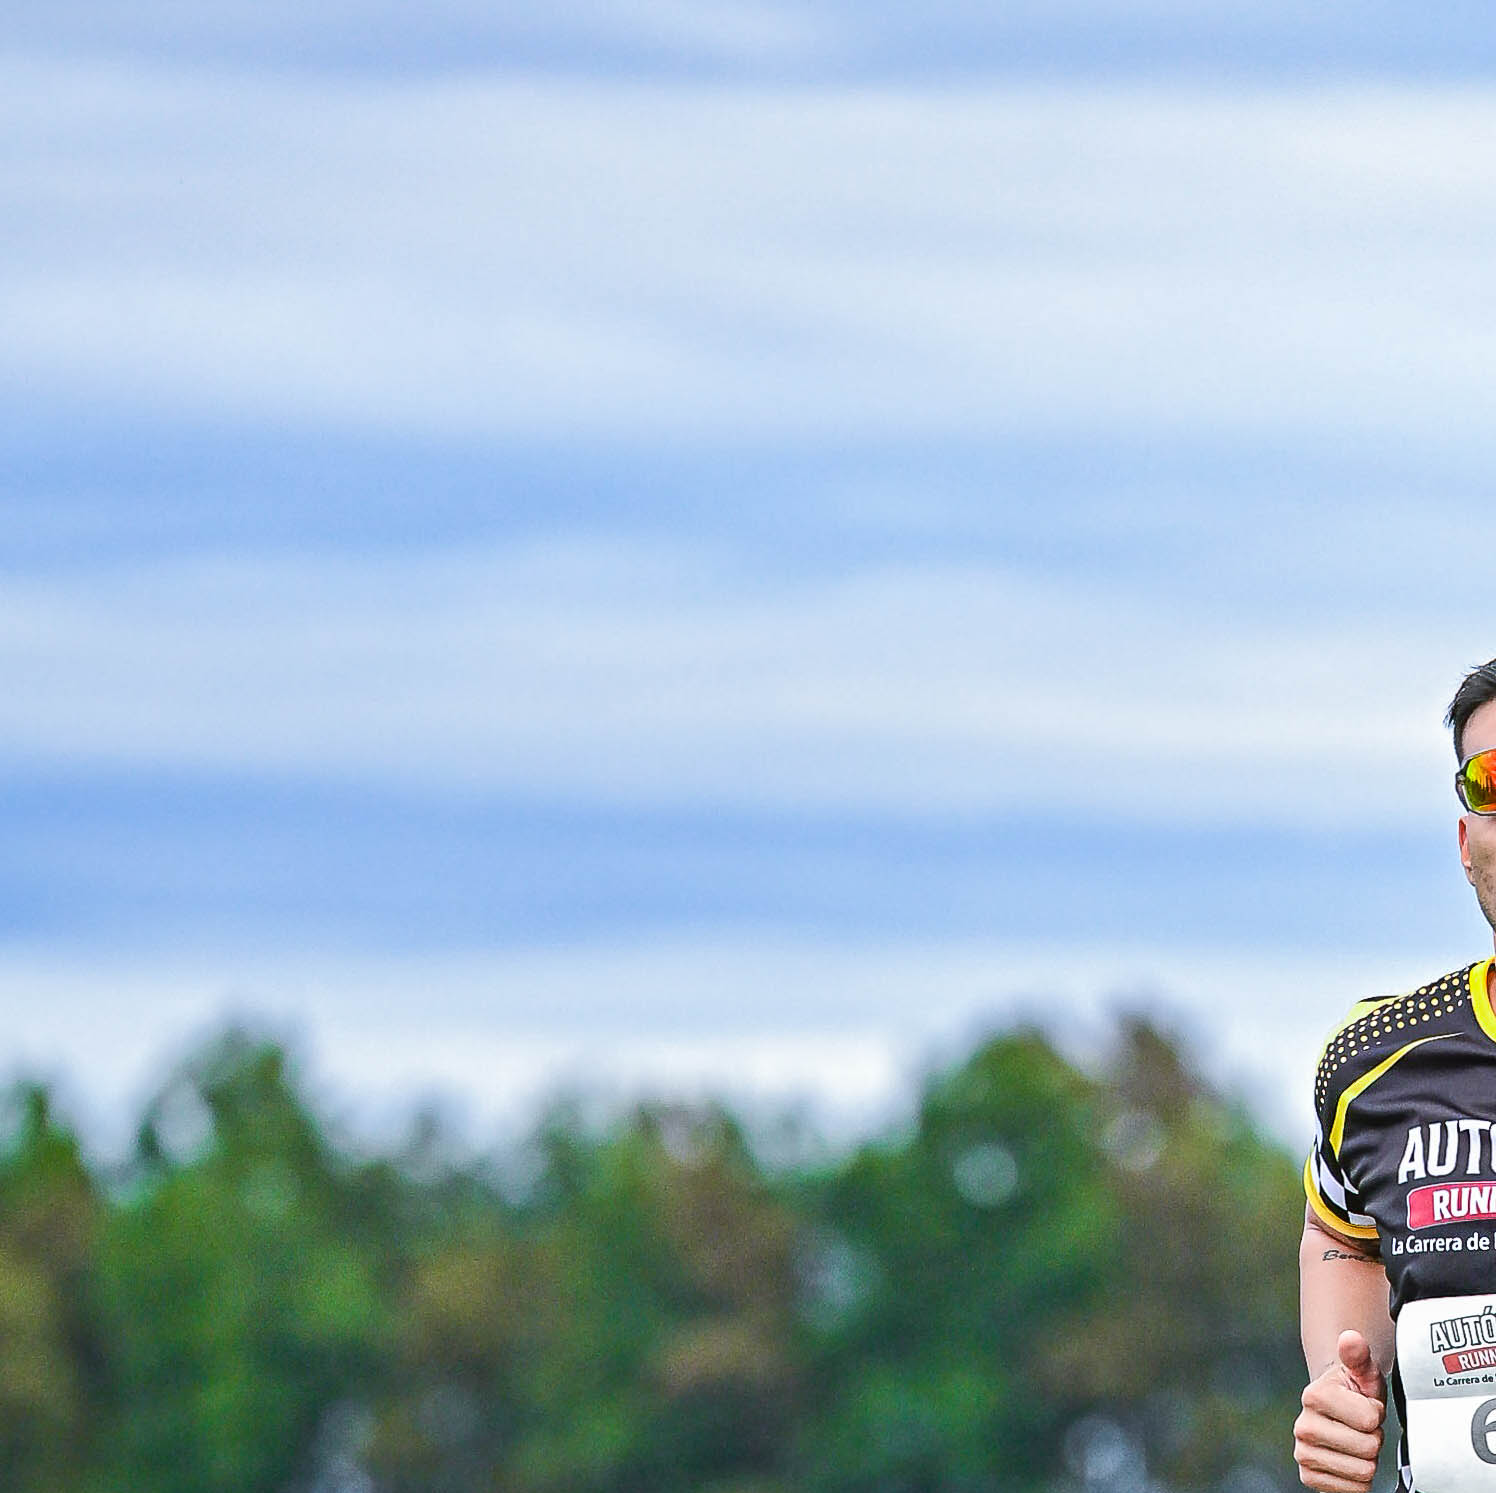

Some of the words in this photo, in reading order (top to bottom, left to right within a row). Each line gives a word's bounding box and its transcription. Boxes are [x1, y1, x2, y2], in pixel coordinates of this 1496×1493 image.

[1391, 1235, 1404, 1256] La
[1405, 1233, 1462, 1253] Carrera
[1466, 1231, 1490, 1251] de
[1433, 1377, 1445, 1387] La
[1446, 1376, 1480, 1386] Carrera
[1481, 1374, 1494, 1384] de
